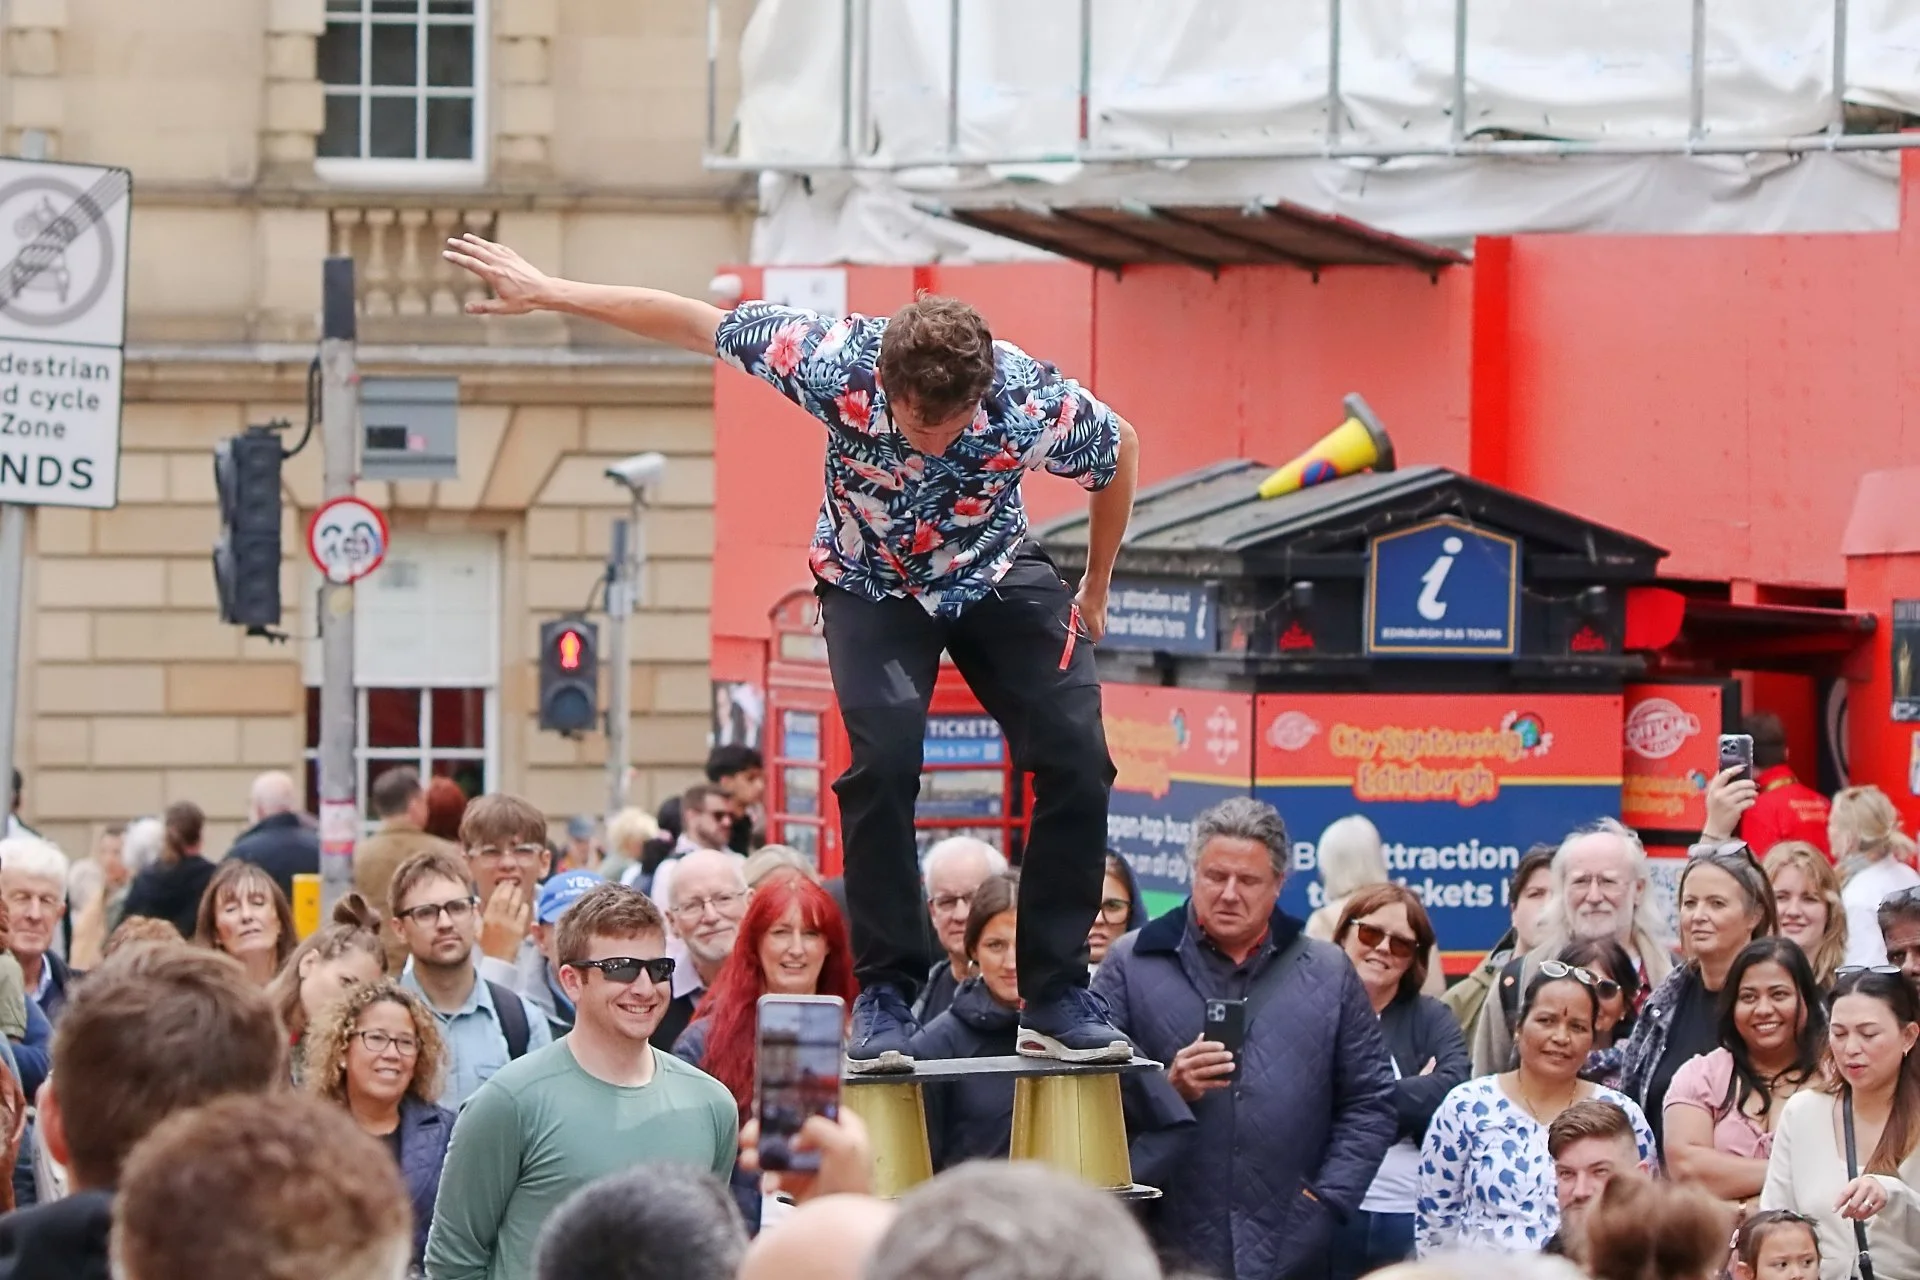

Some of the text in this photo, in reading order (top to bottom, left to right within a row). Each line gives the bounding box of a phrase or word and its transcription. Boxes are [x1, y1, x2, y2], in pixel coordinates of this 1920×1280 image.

[29, 386, 100, 413] cycle
[1, 412, 66, 439] Zone
[1382, 627, 1502, 641] EDINBURGH BUS TOURS
[929, 719, 1000, 738] TICKETS
[1331, 724, 1380, 759] City
[1359, 764, 1494, 799] Edinburgh
[1382, 838, 1519, 870] ttraction
